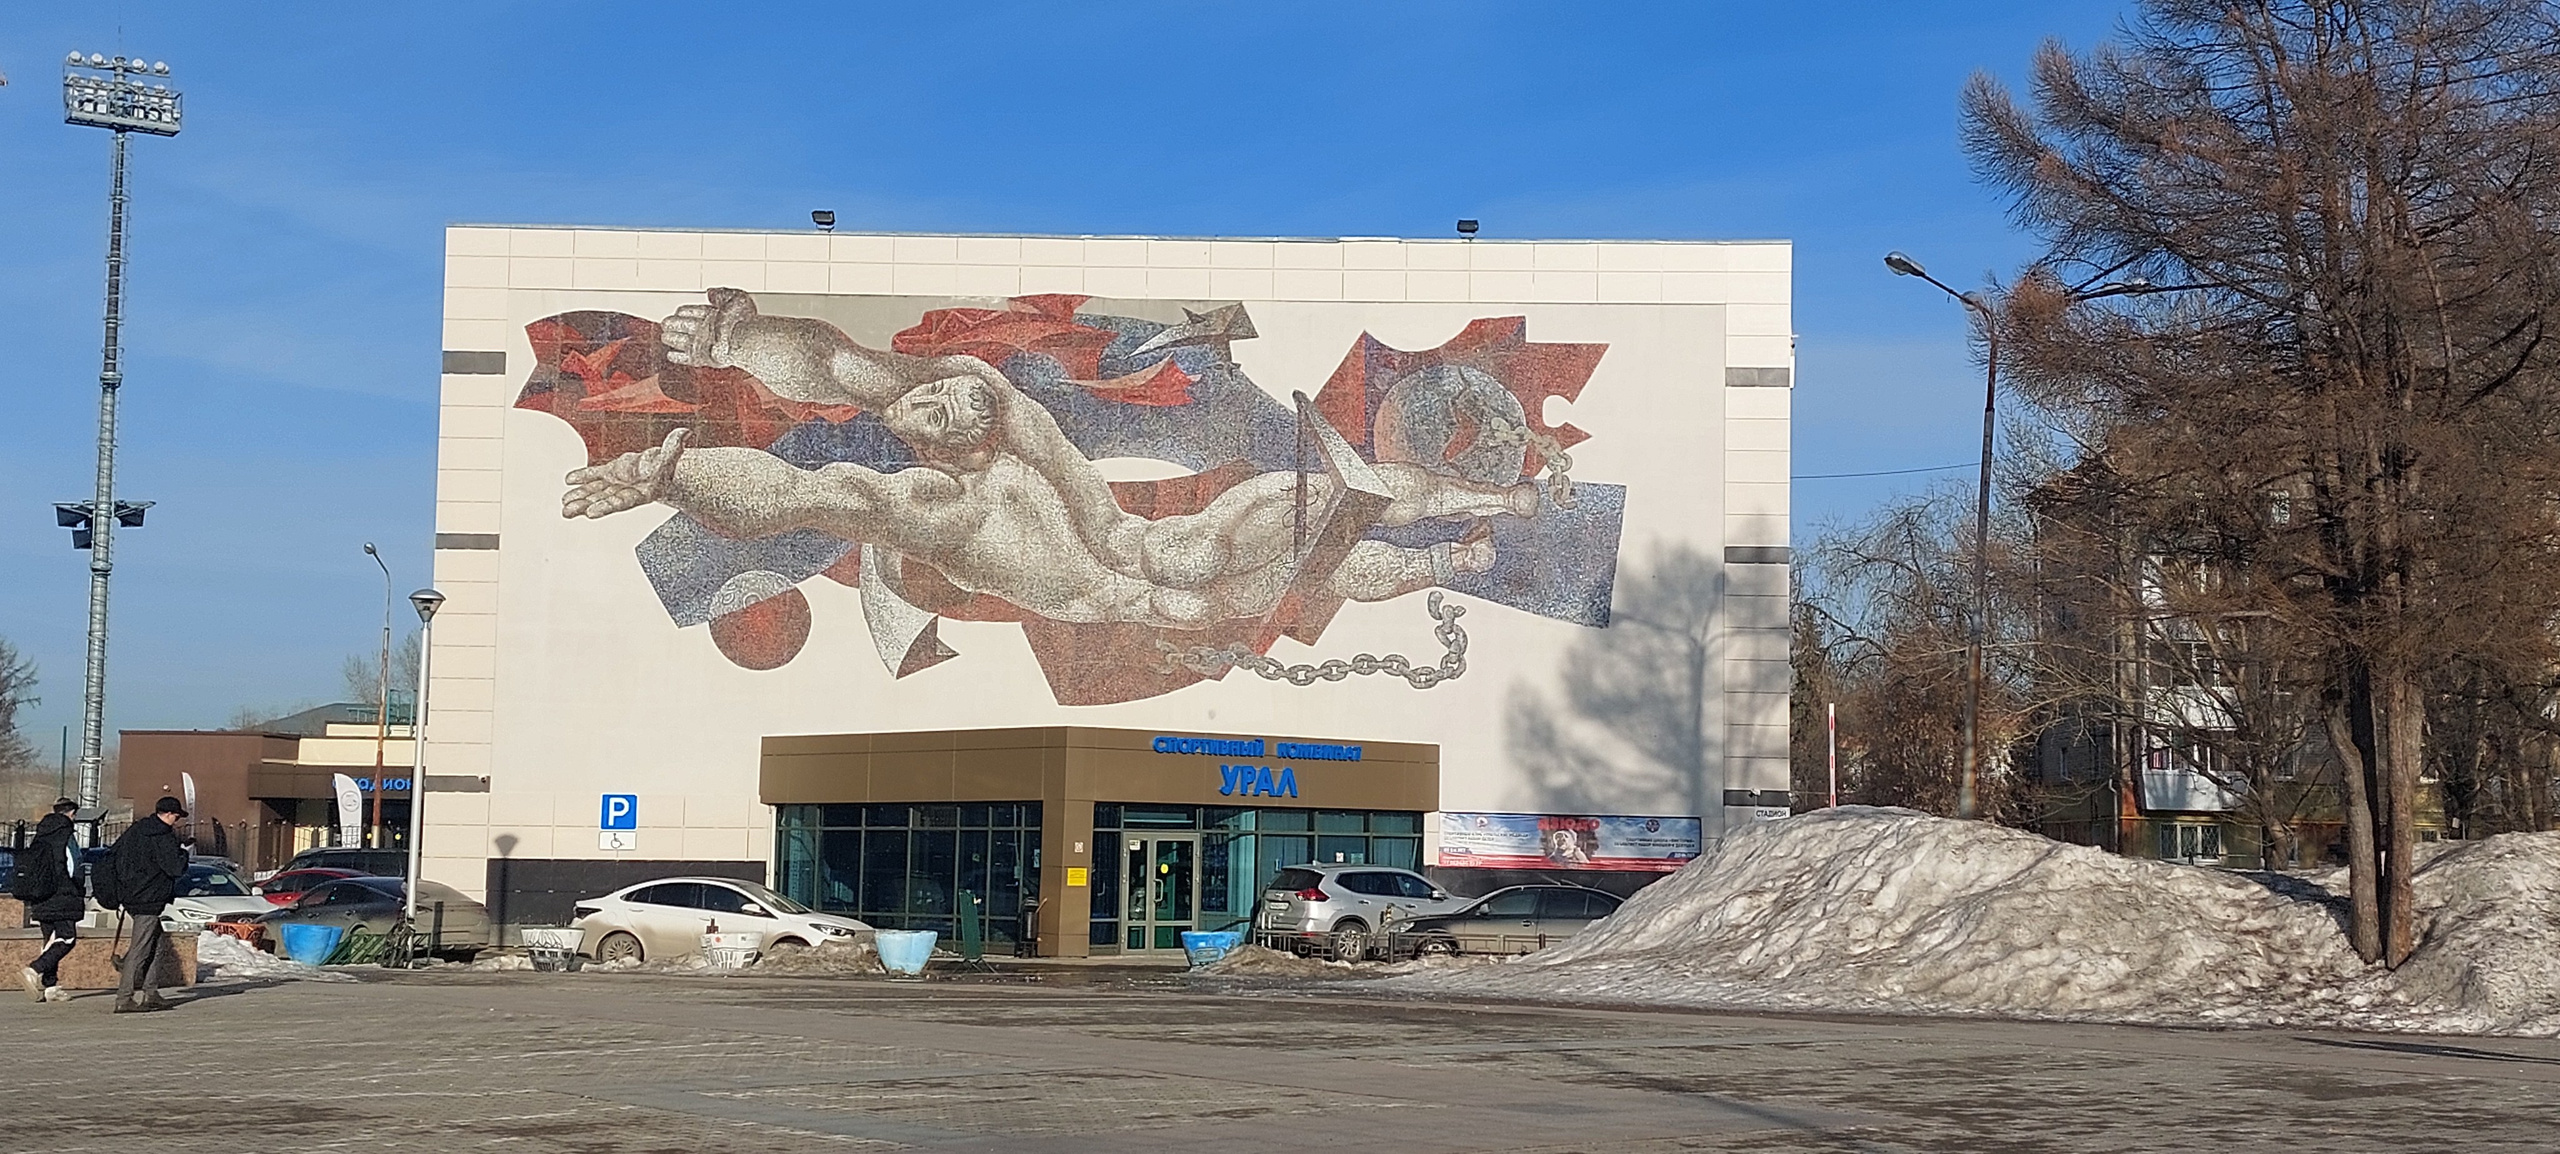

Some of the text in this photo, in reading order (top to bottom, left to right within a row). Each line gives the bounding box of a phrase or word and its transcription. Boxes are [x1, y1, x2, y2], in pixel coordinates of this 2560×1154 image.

[1153, 736, 1362, 761] СПОРТИВНЫЙ КОМБИНАТ
[1218, 765, 1298, 797] УРАЛ
[608, 797, 630, 826] P
[1756, 809, 1787, 818] СТАДИОН
